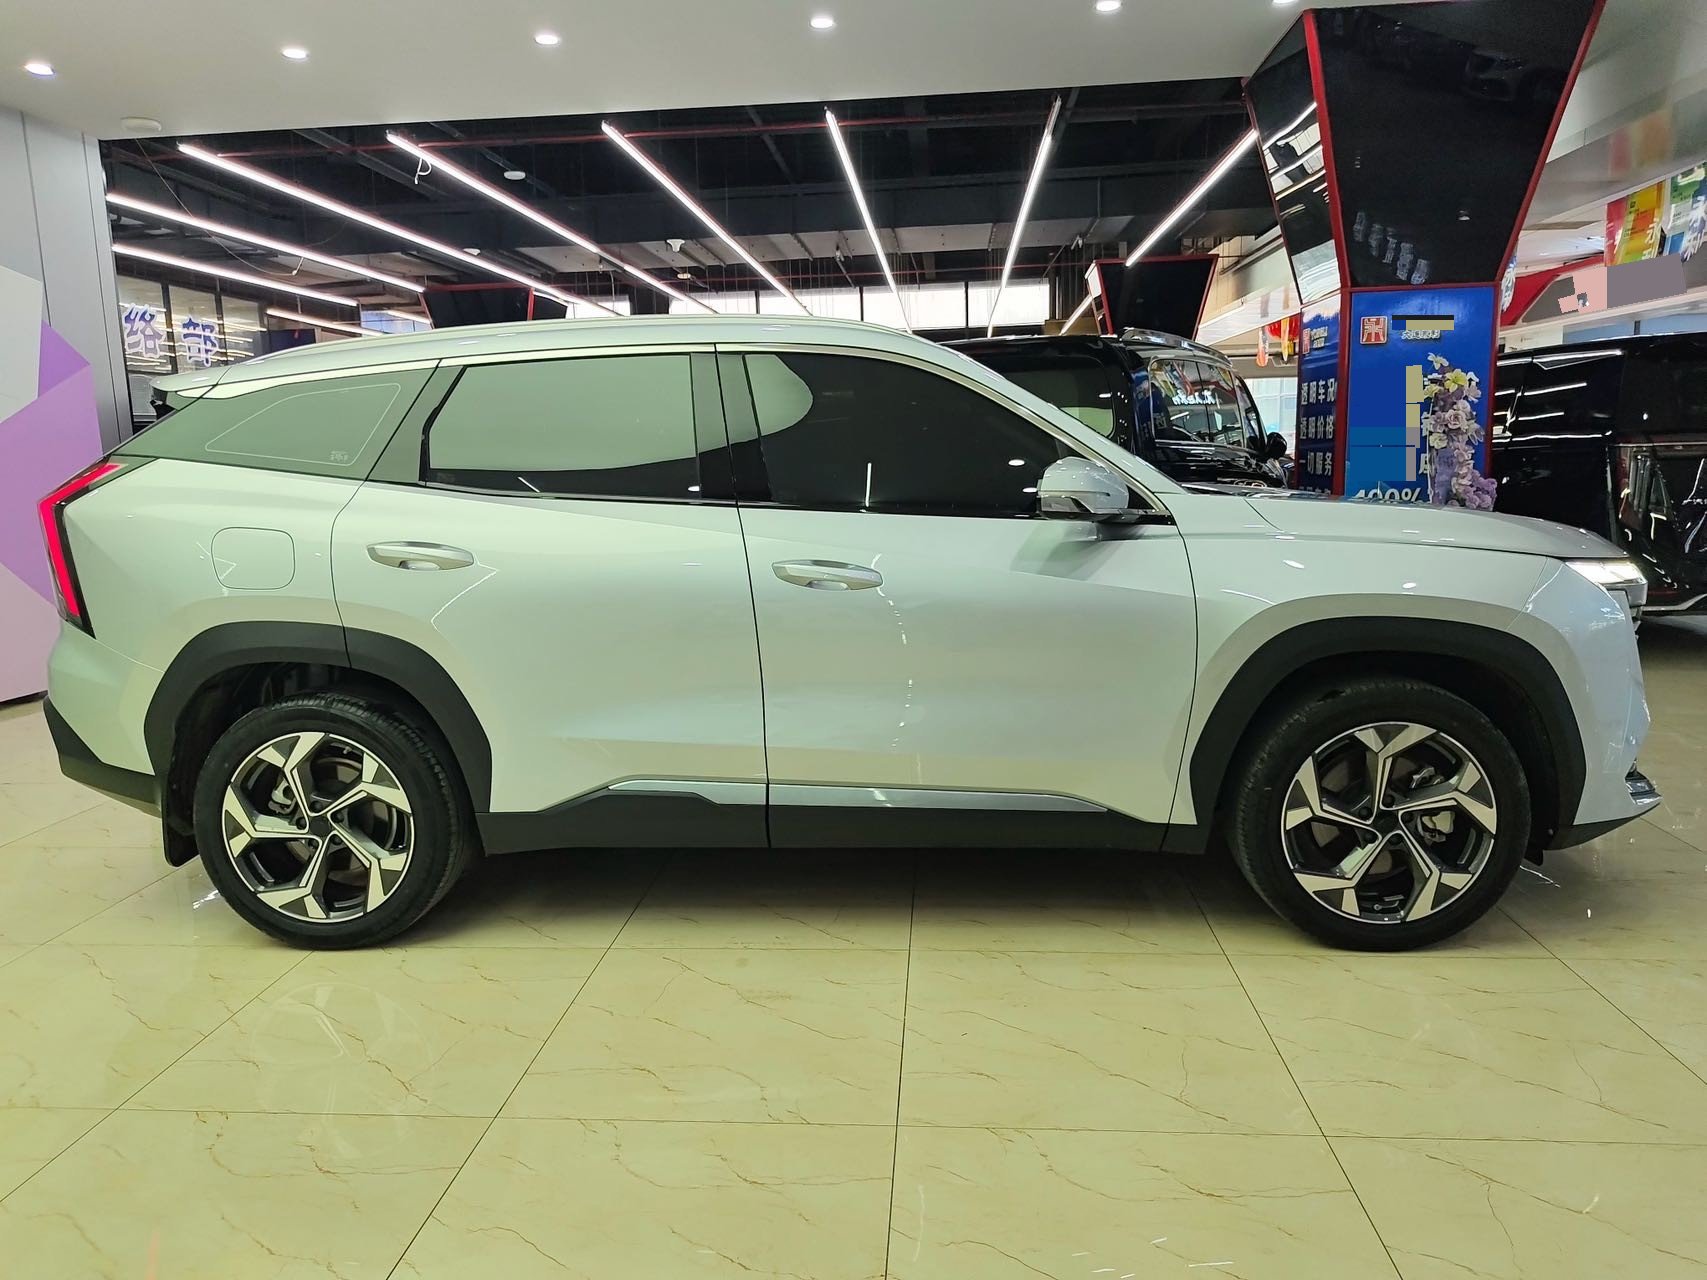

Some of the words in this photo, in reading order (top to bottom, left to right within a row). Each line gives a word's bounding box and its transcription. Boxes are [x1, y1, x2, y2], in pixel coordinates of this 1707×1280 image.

[1301, 378, 1336, 405] 透明车况
[1300, 415, 1334, 440] 透明价格
[1299, 451, 1333, 476] 一切服务
